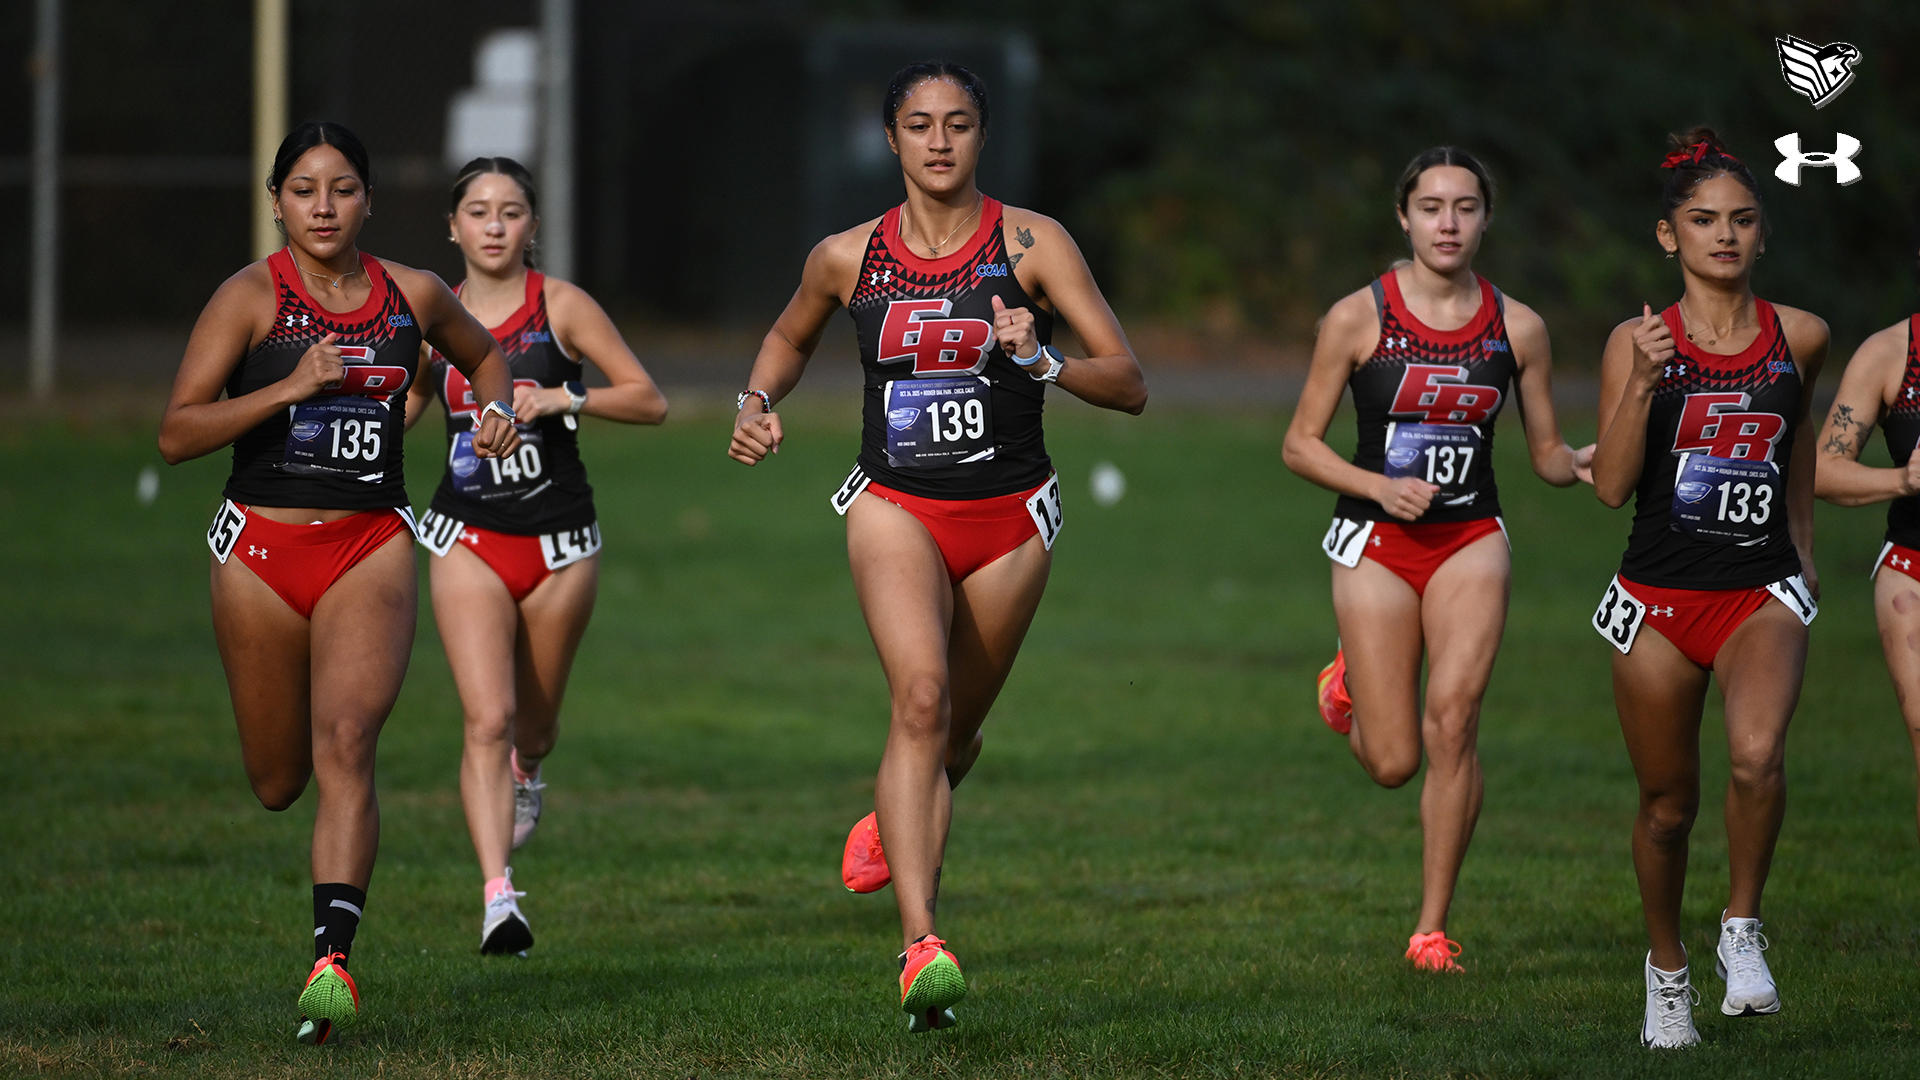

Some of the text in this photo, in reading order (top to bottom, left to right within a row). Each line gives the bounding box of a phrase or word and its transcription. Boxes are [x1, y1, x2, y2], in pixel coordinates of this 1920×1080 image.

[976, 263, 1007, 277] CCAA
[388, 314, 413, 327] CCAA
[521, 331, 550, 343] CCAA
[877, 298, 996, 378] EB
[1483, 340, 1508, 352] CCAA
[1766, 361, 1794, 374] CCAA
[1388, 363, 1502, 427] EB
[330, 418, 382, 461] 135
[926, 399, 985, 442] 139
[1670, 391, 1787, 462] EB
[485, 443, 543, 485] 140
[1424, 445, 1474, 484] 137
[1717, 481, 1773, 525] 133
[551, 525, 599, 563] 140
[1597, 583, 1638, 645] 33
